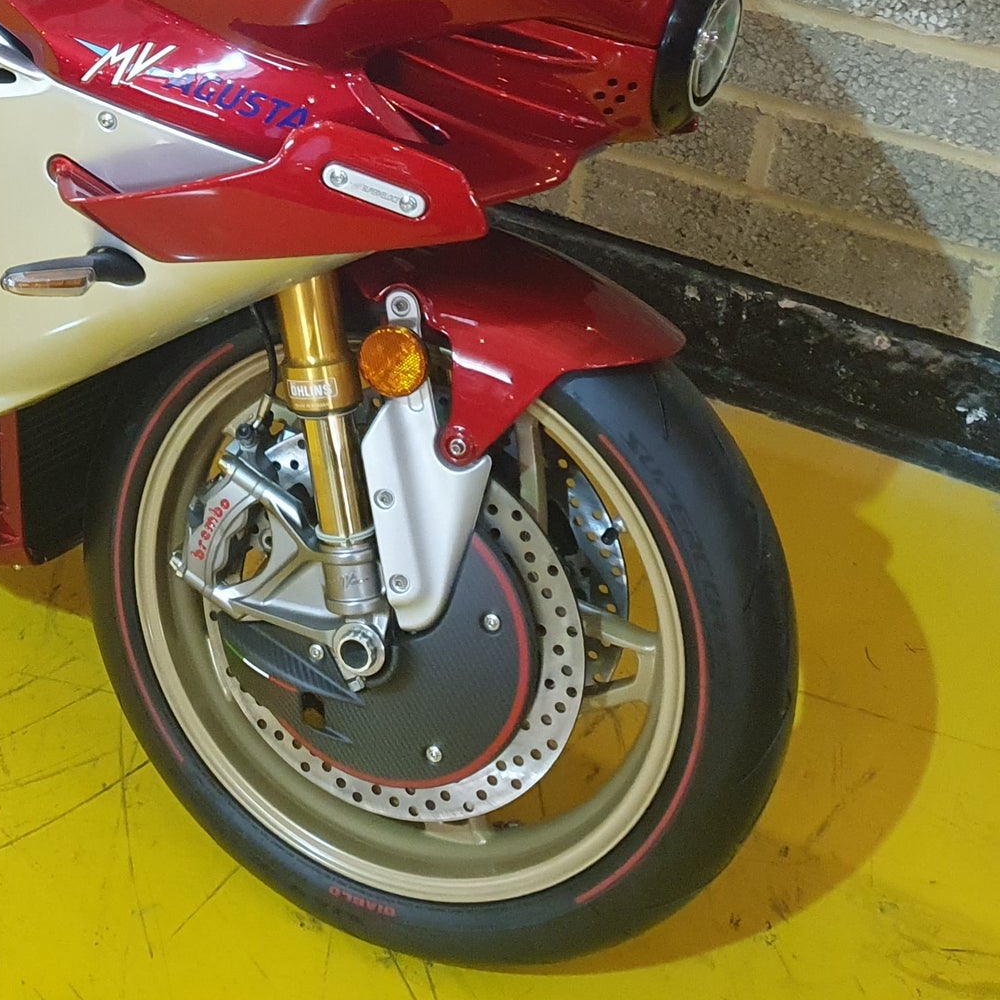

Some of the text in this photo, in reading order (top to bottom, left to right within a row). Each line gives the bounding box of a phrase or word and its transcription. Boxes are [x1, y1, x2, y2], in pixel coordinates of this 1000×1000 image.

[80, 41, 311, 129] MV AGUSTA
[190, 499, 230, 561] brembo
